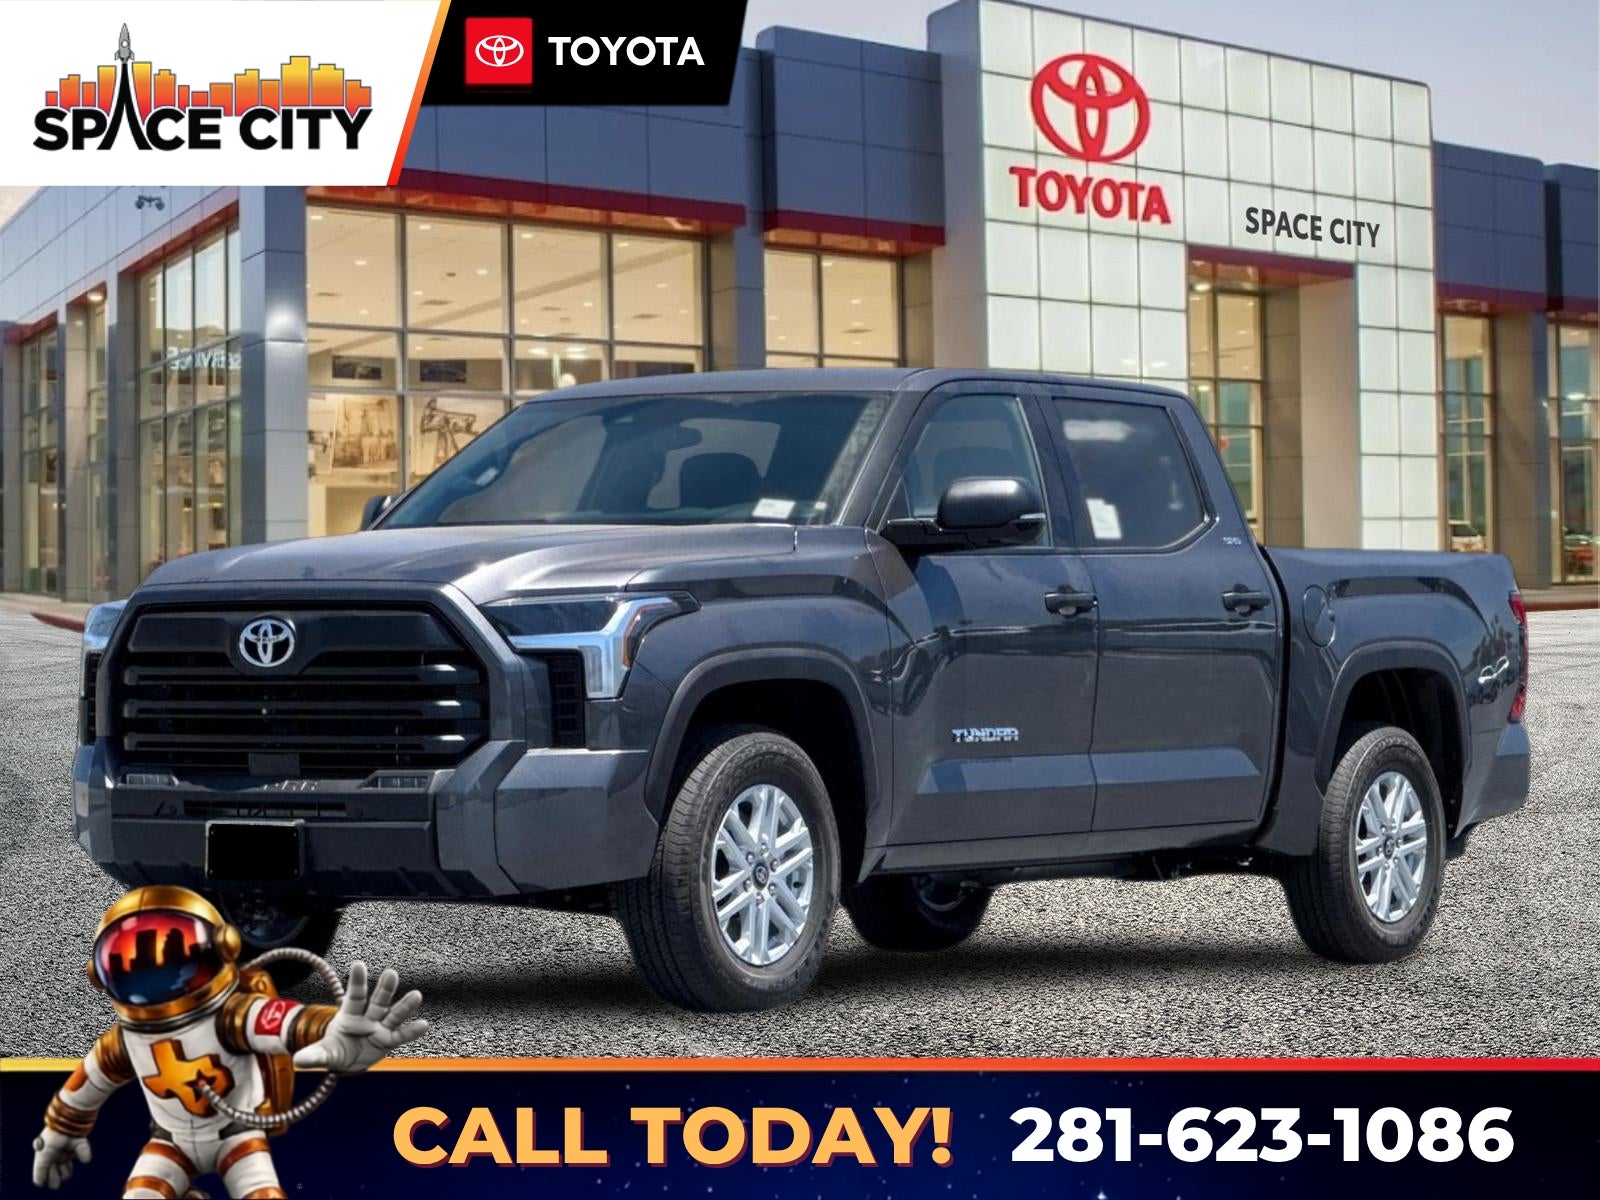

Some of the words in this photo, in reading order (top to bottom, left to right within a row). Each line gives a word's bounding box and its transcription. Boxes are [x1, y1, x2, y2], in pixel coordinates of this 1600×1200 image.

[1009, 166, 1171, 224] TOYOTA
[1245, 206, 1323, 242] SPACE
[1329, 218, 1381, 248] CITY
[951, 727, 1019, 743] TUNDRA
